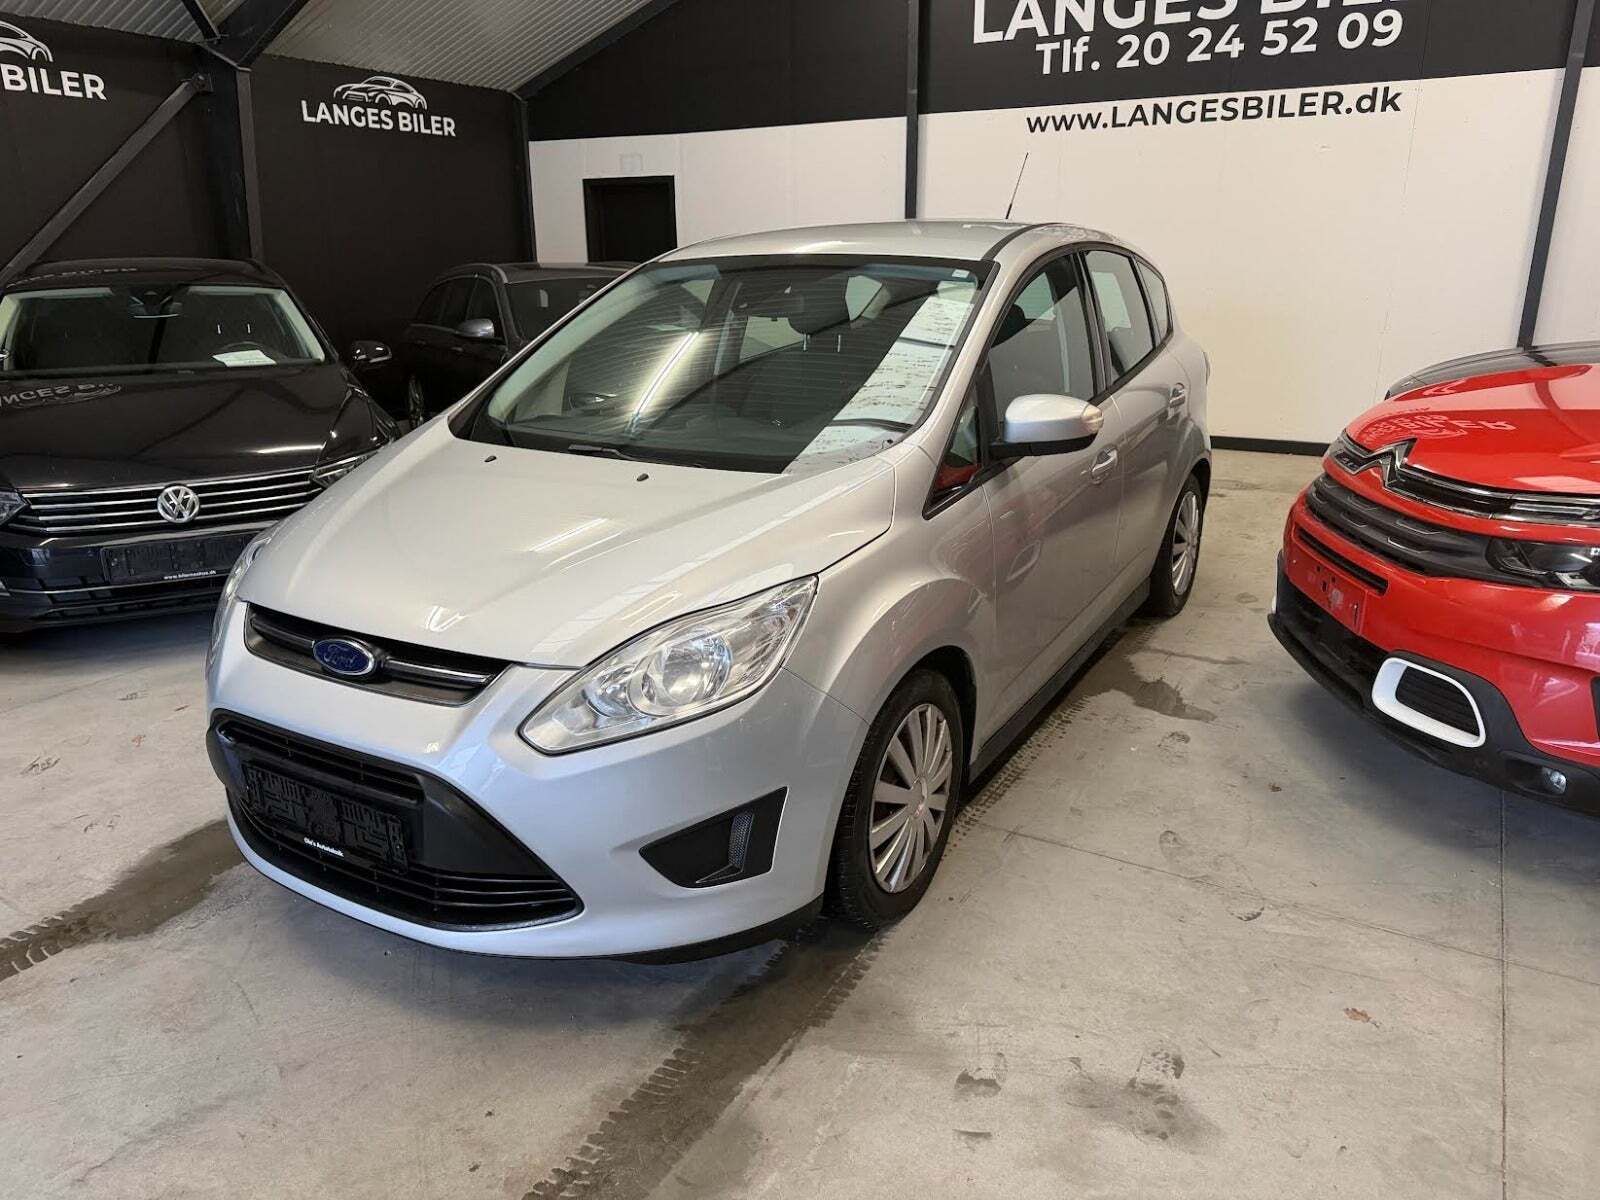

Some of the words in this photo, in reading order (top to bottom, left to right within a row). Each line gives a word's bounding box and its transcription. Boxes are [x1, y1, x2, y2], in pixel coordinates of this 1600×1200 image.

[1036, 36, 1101, 74] Tlf.
[1116, 30, 1170, 68] 20
[1187, 24, 1245, 62] 24
[1260, 17, 1317, 55] 52
[1337, 9, 1403, 49] 09
[0, 63, 107, 100] BILER
[301, 100, 394, 130] LANGES
[398, 111, 456, 137] BILER
[1026, 86, 1402, 133] www.LANGESBILER.dk
